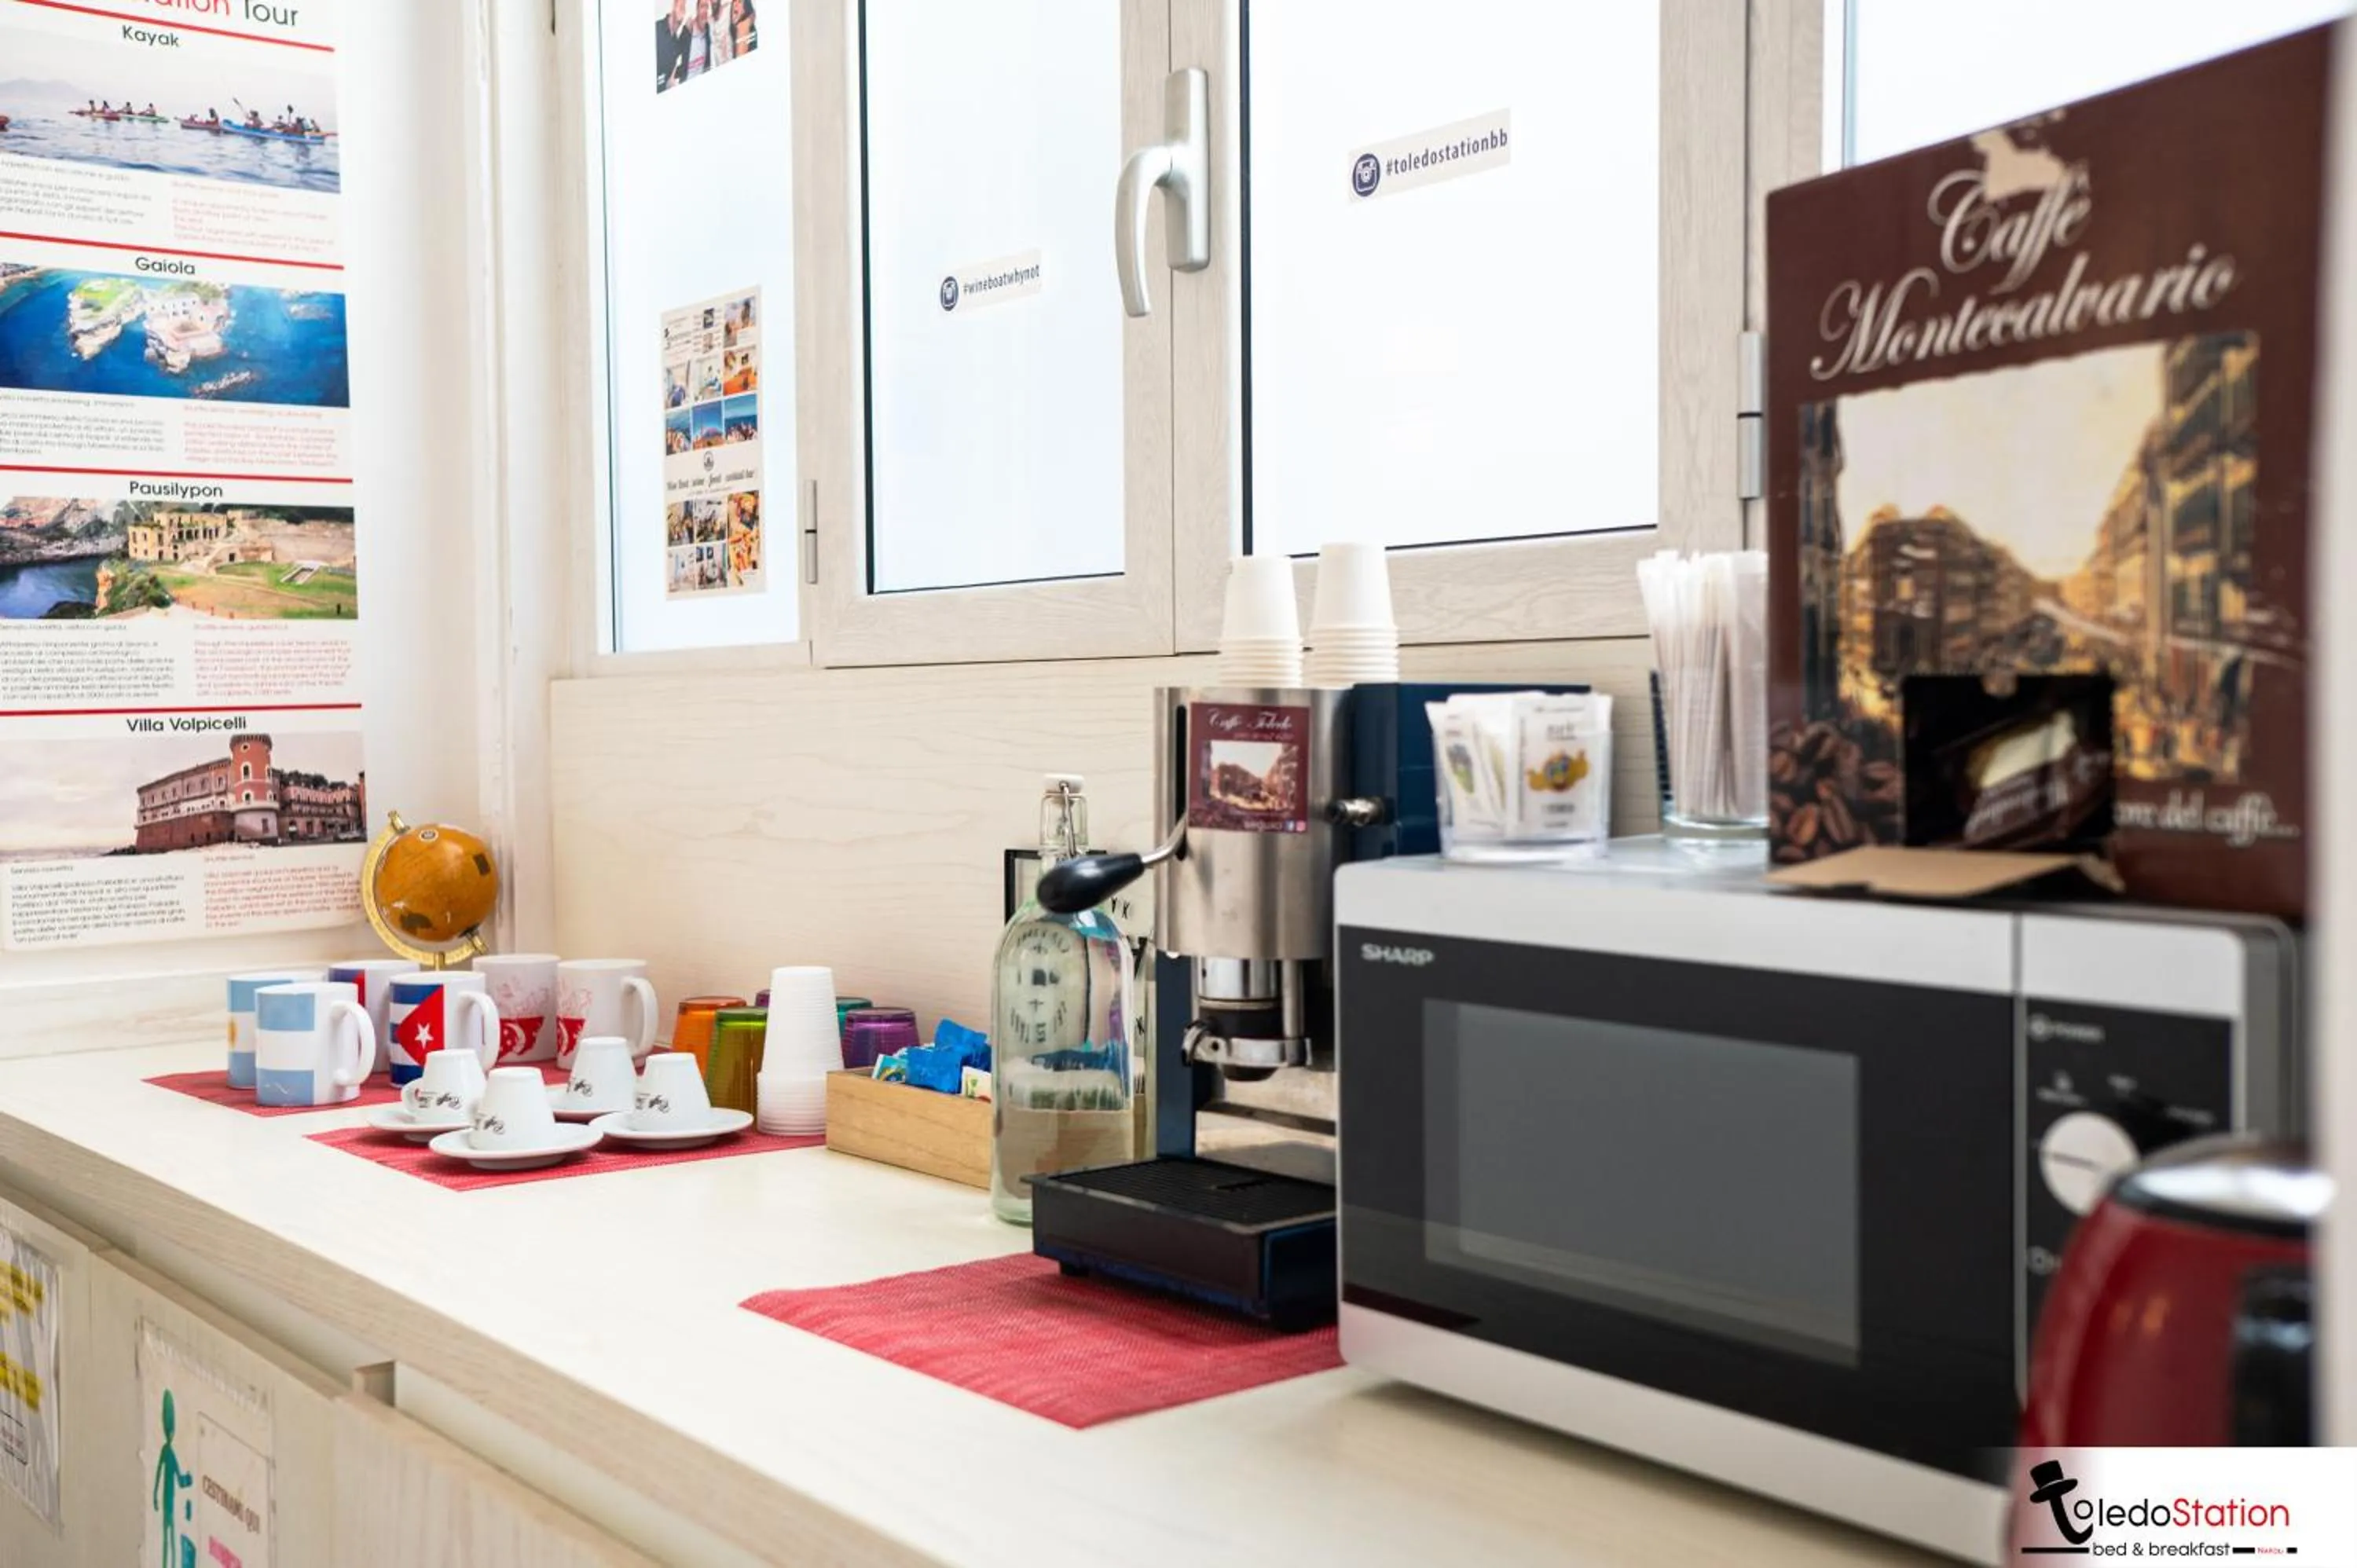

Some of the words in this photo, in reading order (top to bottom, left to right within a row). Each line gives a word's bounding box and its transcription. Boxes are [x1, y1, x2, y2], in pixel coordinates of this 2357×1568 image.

[122, 24, 180, 47] Kayak
[1386, 128, 1508, 176] #toledostationbb
[134, 257, 196, 275] Gaiola
[1809, 244, 2235, 380] Montecalvario
[129, 480, 223, 499] Pausilypon
[126, 718, 164, 732] Villa
[170, 716, 247, 733] Volpicelli
[1361, 943, 1435, 965] SHARP
